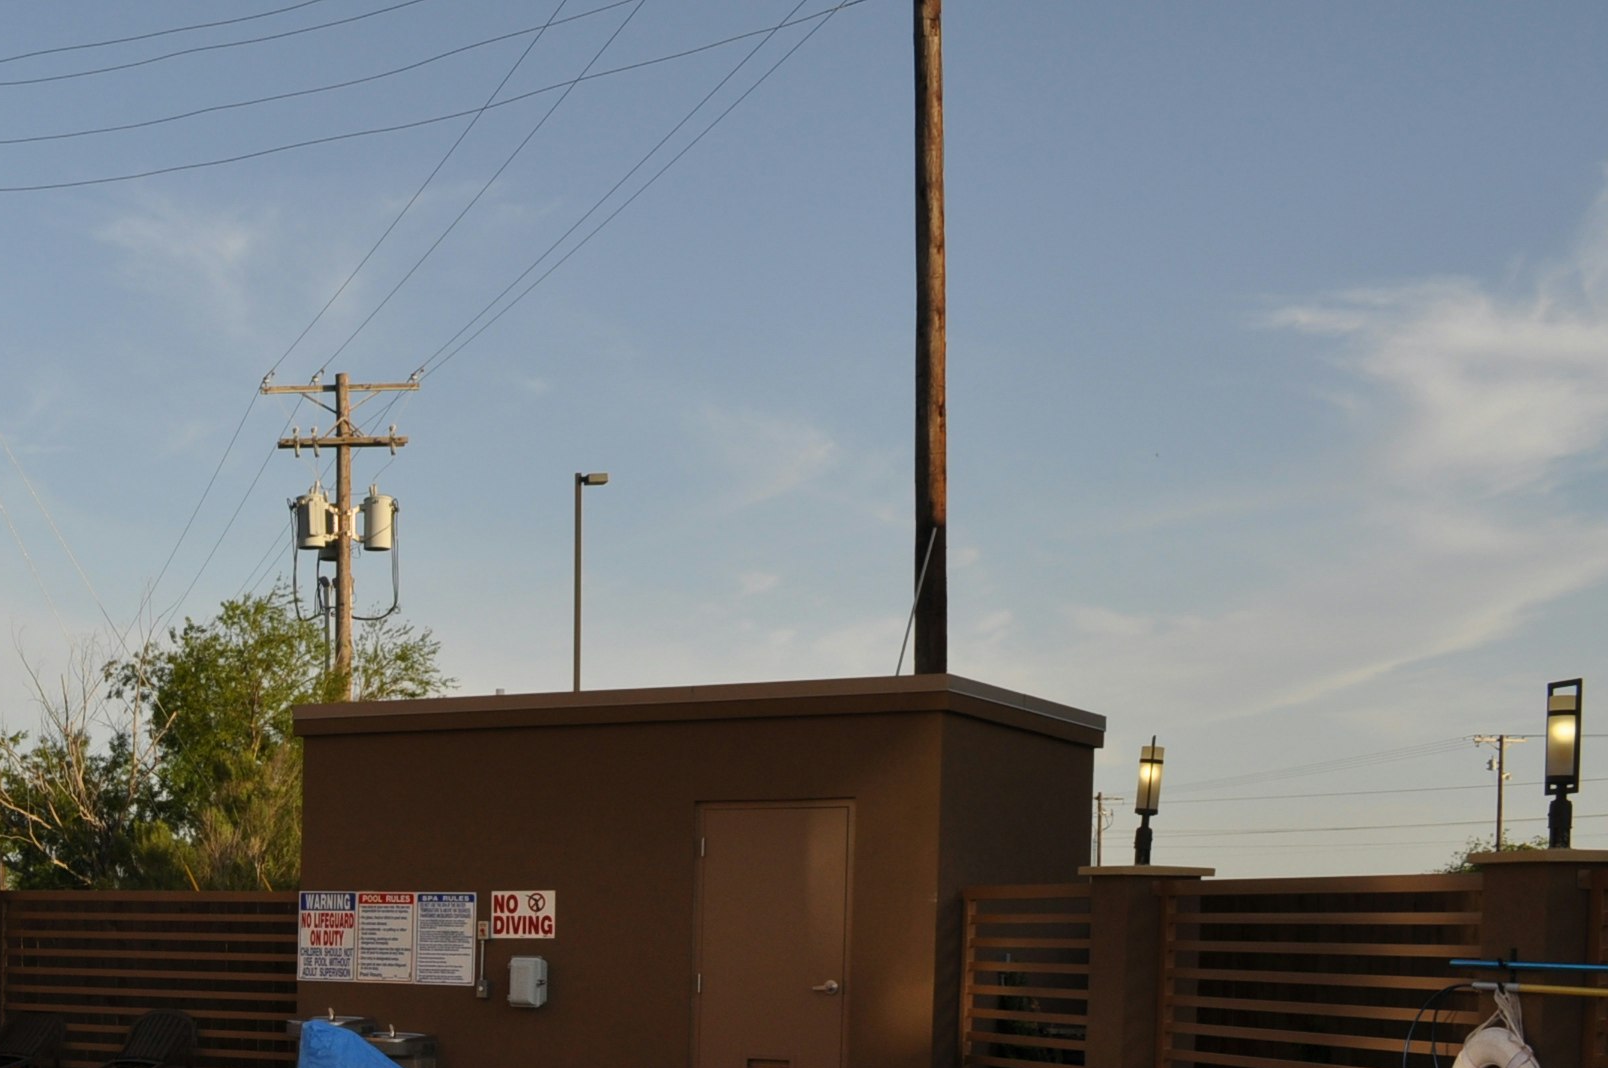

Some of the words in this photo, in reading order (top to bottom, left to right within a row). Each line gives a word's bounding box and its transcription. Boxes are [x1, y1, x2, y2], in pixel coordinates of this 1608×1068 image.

[305, 894, 351, 910] WARNING
[362, 894, 383, 903] POOL
[385, 894, 411, 903] RULES
[493, 894, 519, 914] NO
[301, 912, 312, 928] NO
[314, 912, 355, 928] LIFEGUARD
[493, 915, 553, 935] DIVING
[310, 930, 321, 946] ON
[324, 930, 344, 946] DUTY
[300, 948, 322, 957] CHILDREN
[324, 948, 342, 957] SHOULD
[344, 948, 354, 957] NOT
[303, 957, 312, 967] USE
[314, 957, 327, 967] POOL
[329, 958, 351, 967] WITHOUT
[302, 967, 317, 976] ADULT
[320, 967, 351, 977] SUPERVISION
